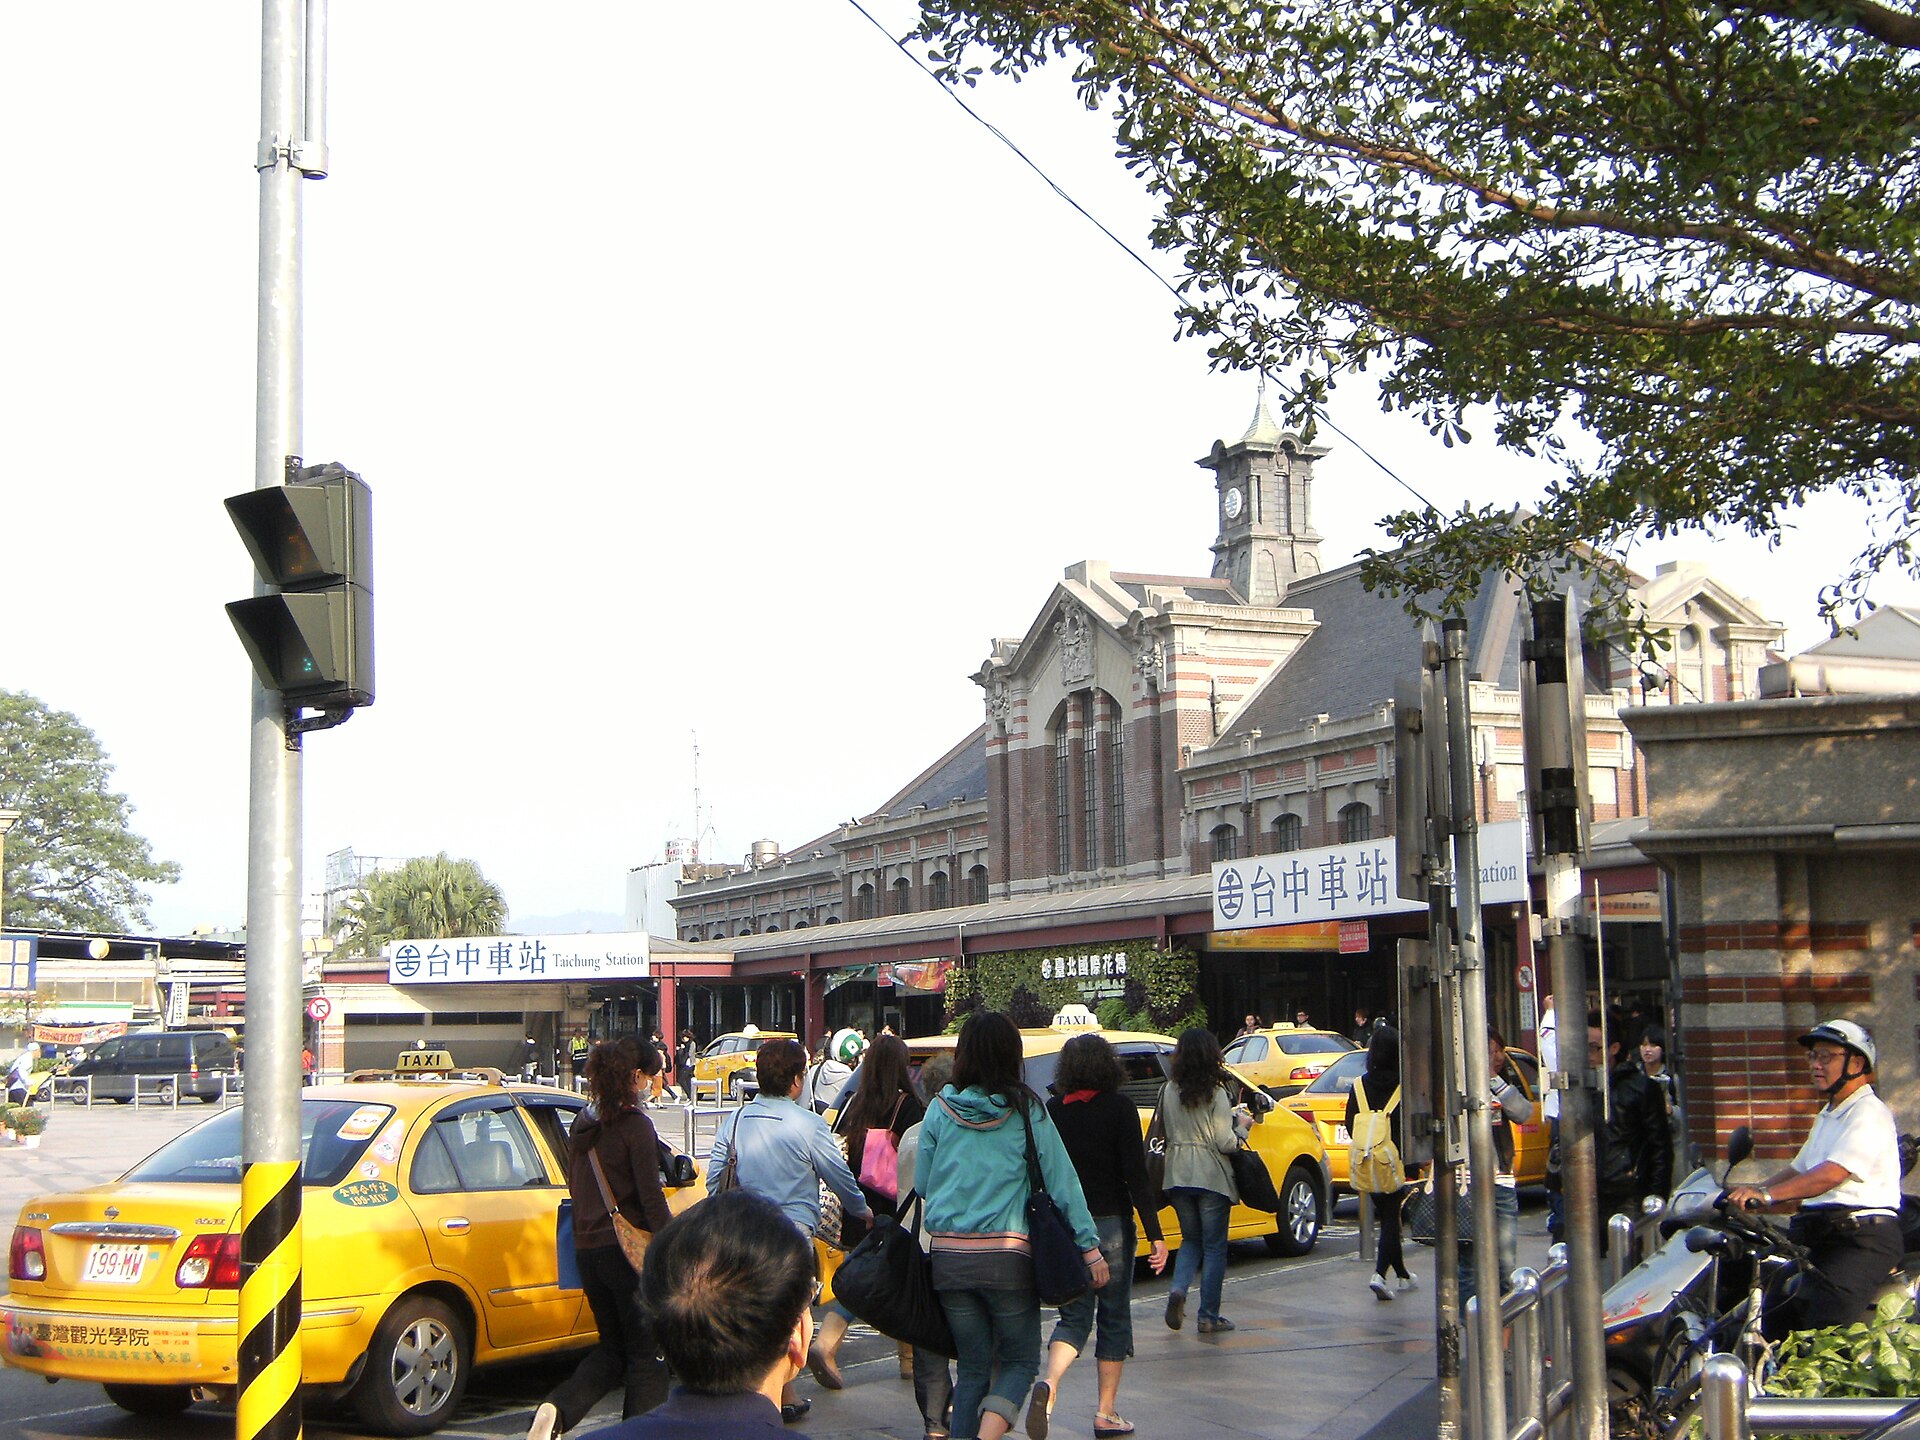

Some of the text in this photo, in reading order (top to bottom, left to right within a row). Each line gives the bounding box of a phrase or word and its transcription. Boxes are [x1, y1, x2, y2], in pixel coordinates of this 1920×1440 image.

[1250, 848, 1388, 919] 台中車站
[427, 940, 547, 977] 台中車站
[552, 951, 644, 972] Taichung Station
[1057, 1015, 1087, 1025] TAXI
[401, 1054, 440, 1067] TAXI
[88, 1251, 144, 1277] 199-MW
[36, 1323, 149, 1347] 臺灣觀光學院
